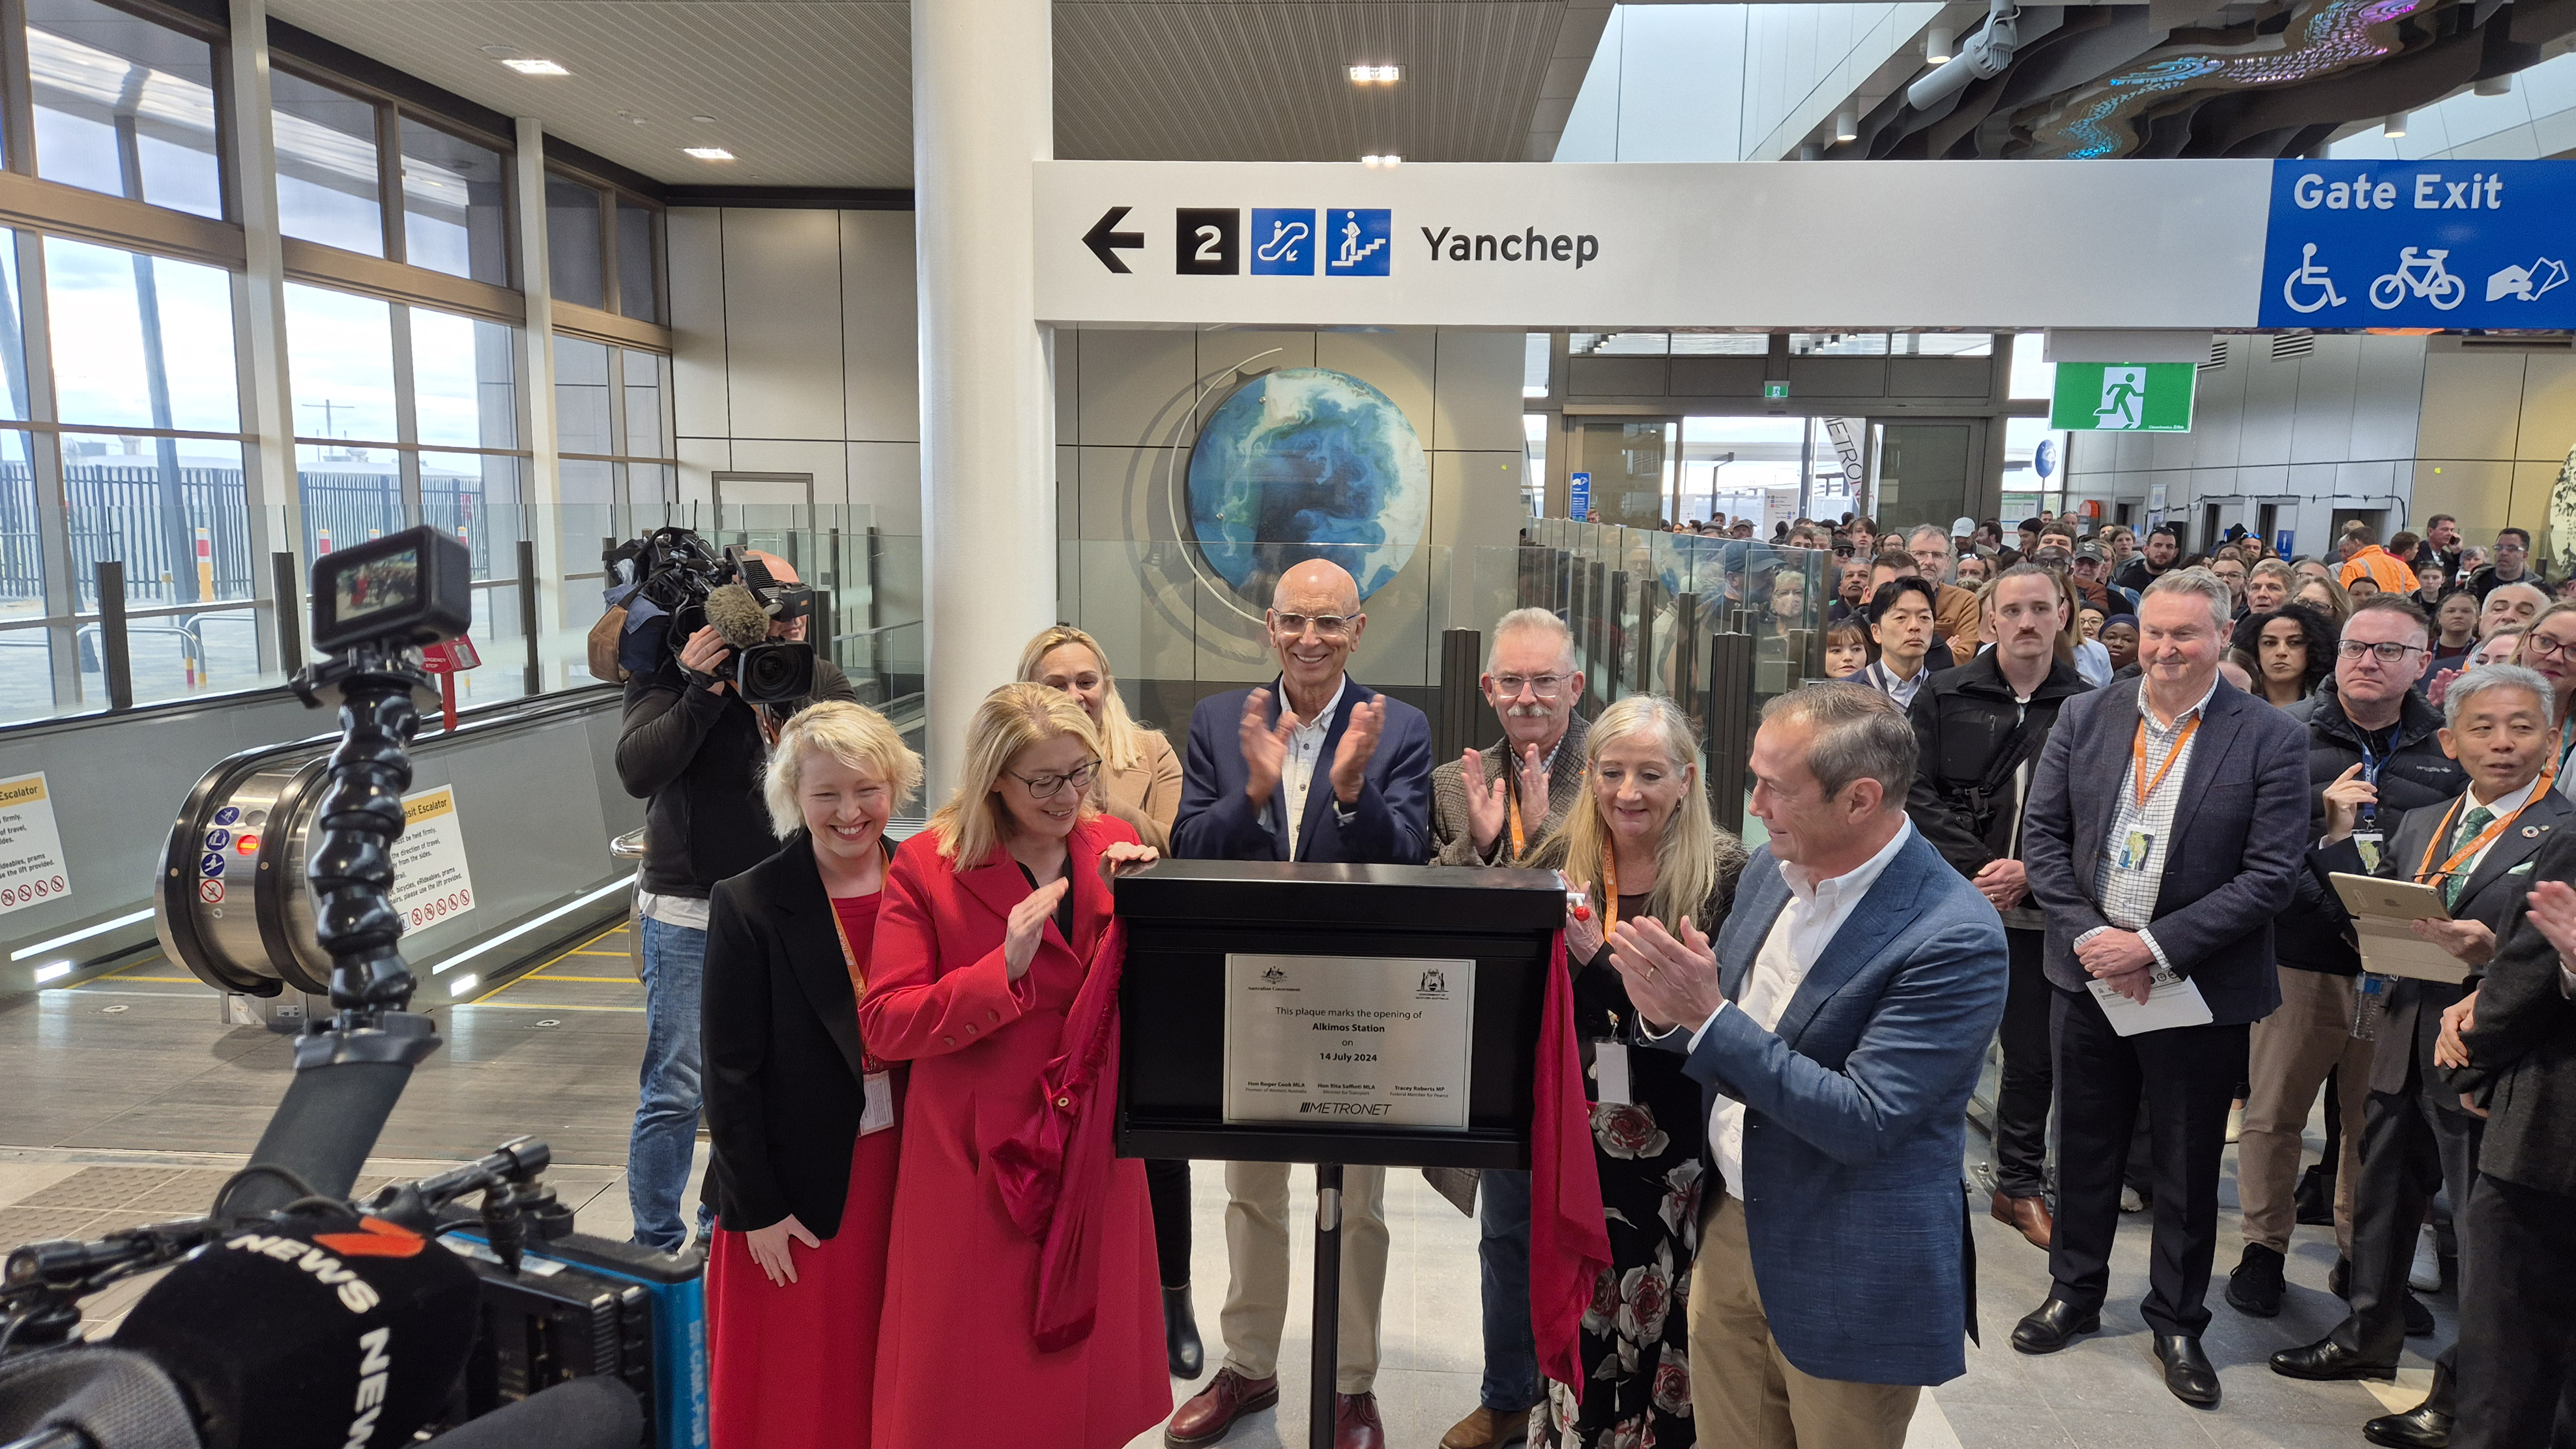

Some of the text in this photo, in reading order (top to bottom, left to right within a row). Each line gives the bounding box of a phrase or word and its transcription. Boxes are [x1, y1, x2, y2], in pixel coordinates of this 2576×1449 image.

[2294, 172, 2503, 211] Gate Exit
[1194, 224, 1599, 270] 2 Yanchep
[404, 798, 447, 819] nsit Escalator
[3, 813, 22, 823] firmly.
[7, 824, 27, 834] travel,
[401, 845, 420, 856] direction
[426, 838, 441, 847] travel,
[27, 853, 46, 864] prams
[398, 858, 410, 866] from
[29, 859, 55, 872] provided.
[442, 867, 455, 877] prams
[404, 890, 418, 901] please
[443, 872, 463, 886] provided.
[1295, 1008, 1326, 1017] plaque
[1357, 1009, 1371, 1017] the
[1374, 1010, 1411, 1020] opening
[1312, 1023, 1385, 1032] Alkimos Station
[1333, 1053, 1352, 1062] July
[1309, 1102, 1393, 1115] METRONET
[225, 1234, 380, 1313] NEWS
